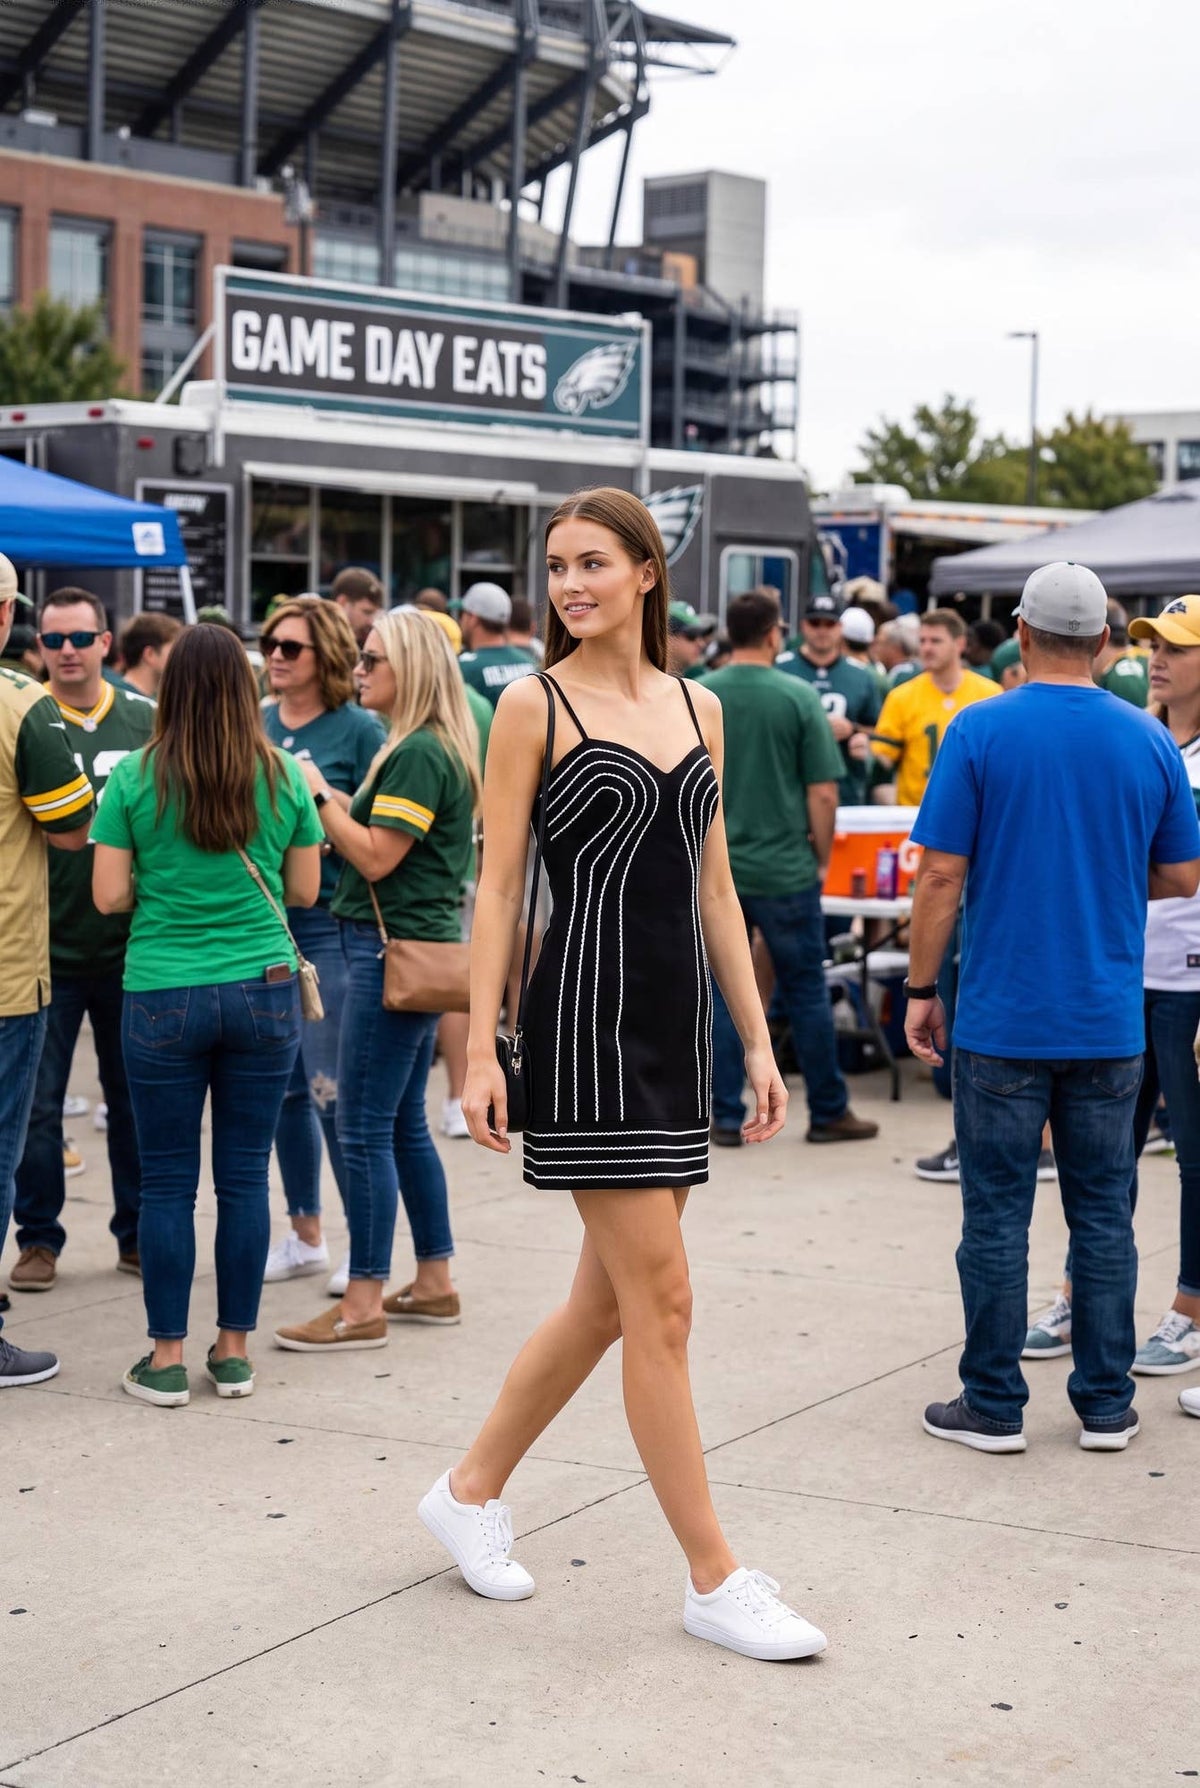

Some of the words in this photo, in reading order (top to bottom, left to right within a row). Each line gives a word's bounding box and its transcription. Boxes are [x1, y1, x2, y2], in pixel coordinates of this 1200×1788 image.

[231, 309, 355, 381] GAME
[365, 325, 445, 390] DAY
[452, 335, 547, 400] EATS
